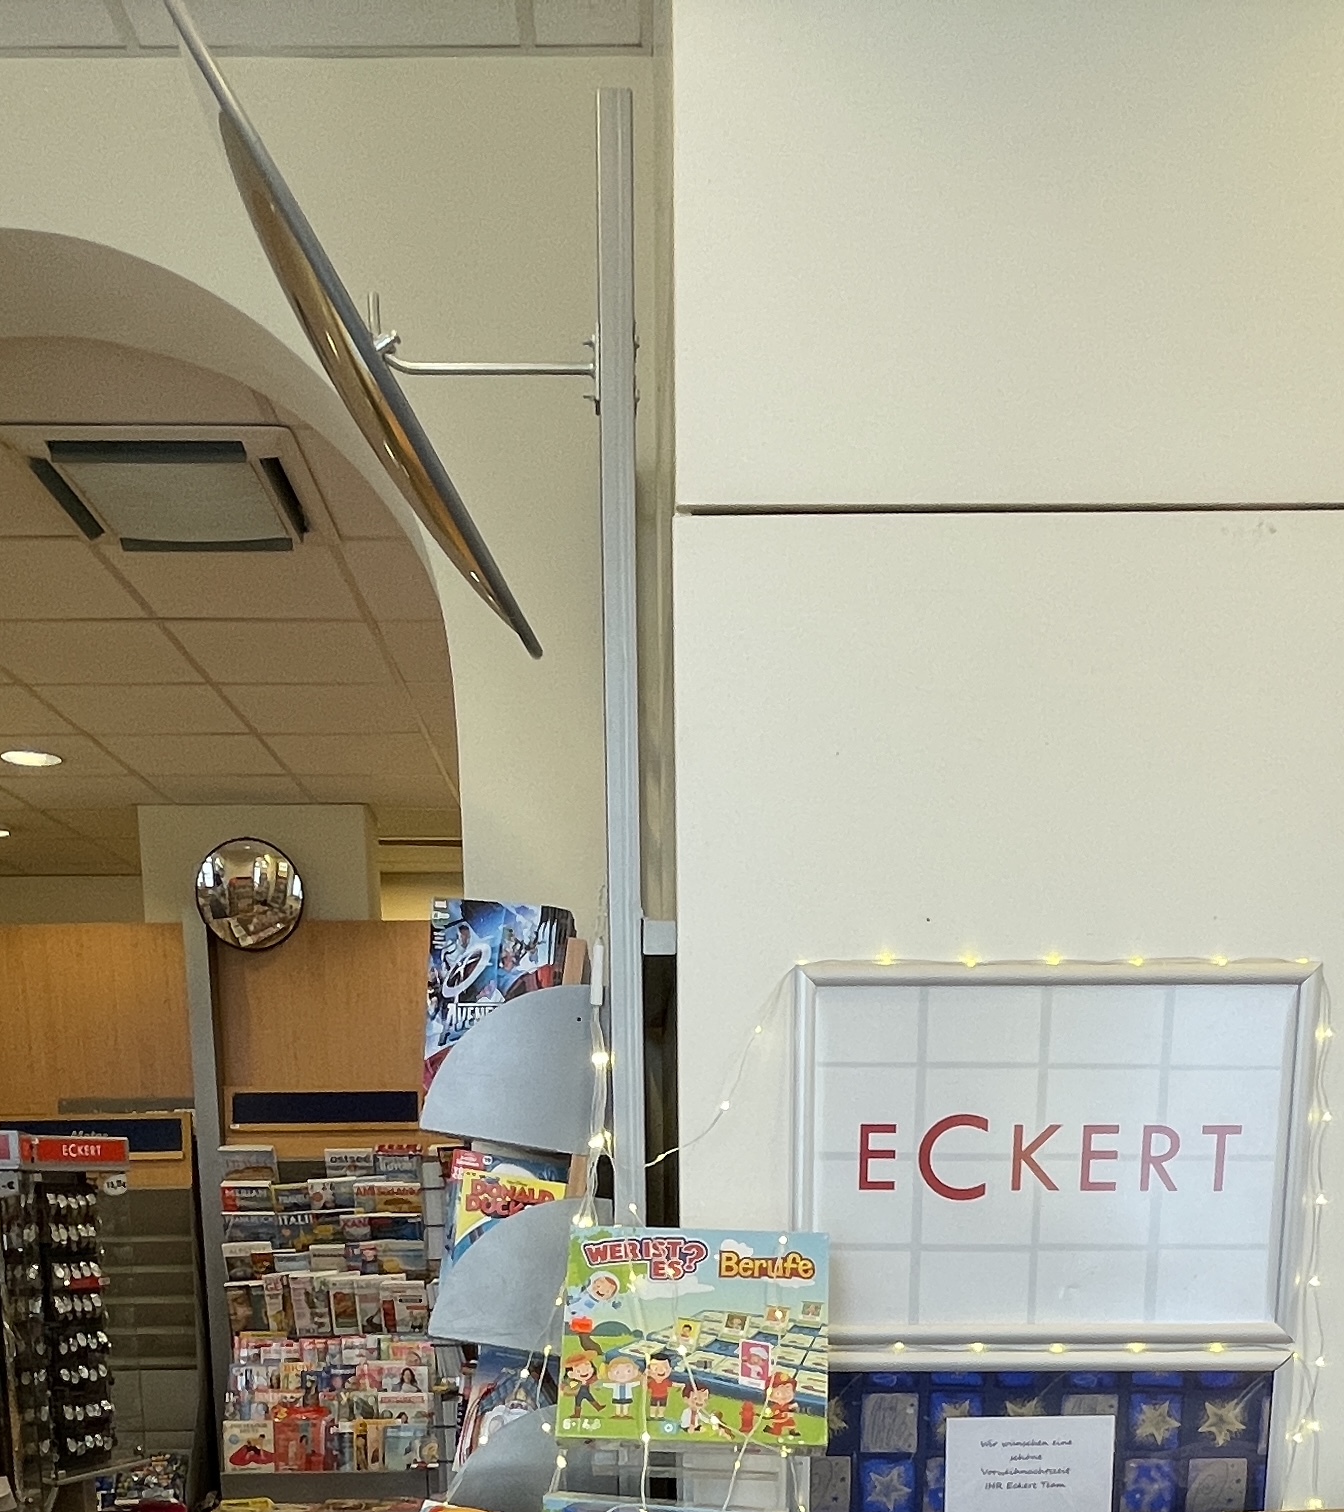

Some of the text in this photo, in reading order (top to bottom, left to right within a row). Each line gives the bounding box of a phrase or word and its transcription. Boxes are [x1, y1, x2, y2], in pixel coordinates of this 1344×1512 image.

[62, 1144, 102, 1158] ECKERT
[858, 1113, 1244, 1201] ECKERT
[471, 1178, 555, 1203] DONALD
[584, 1237, 682, 1266] WER IST
[718, 1249, 816, 1281] Berufe
